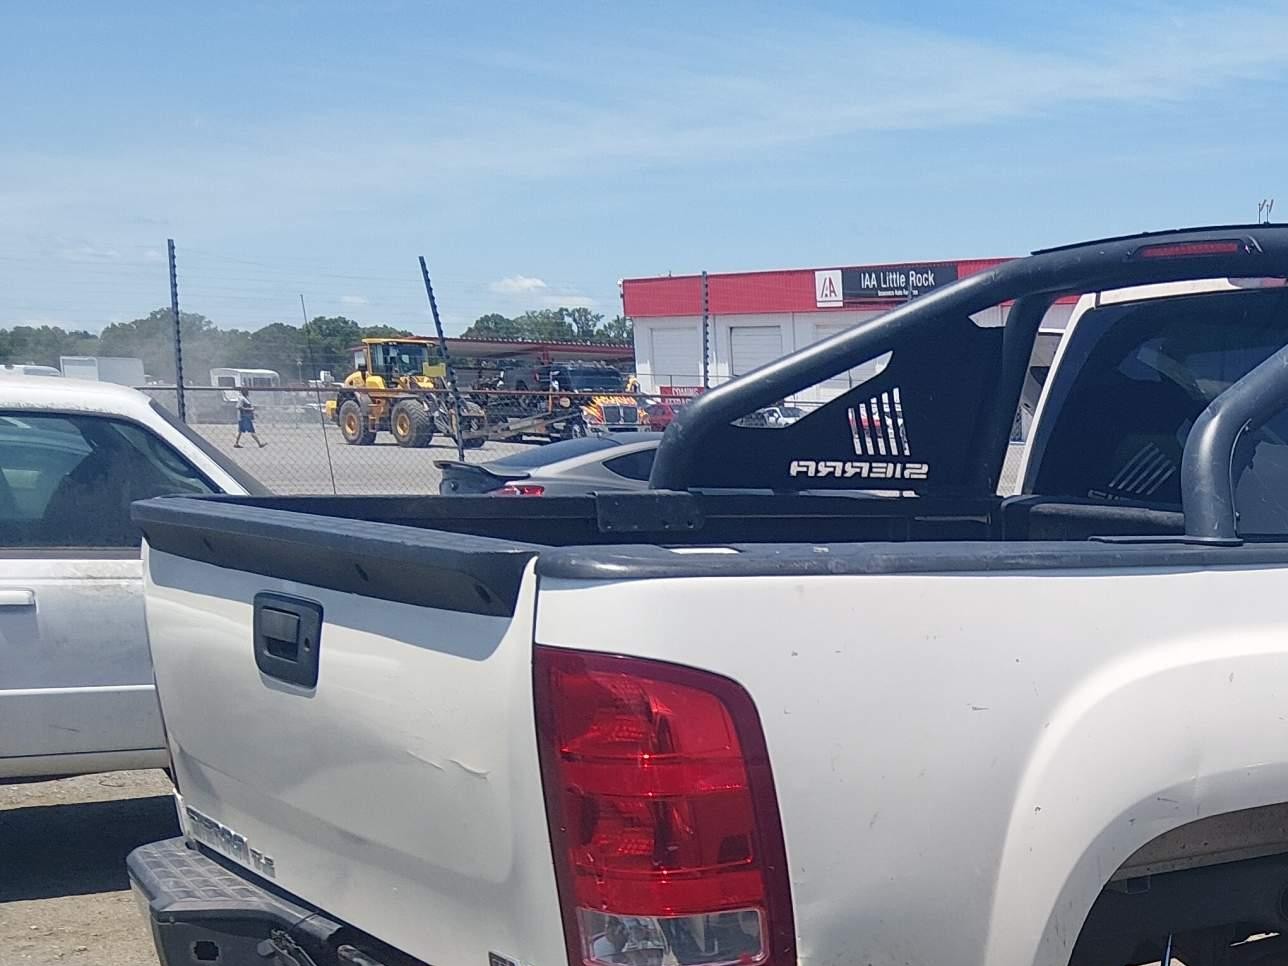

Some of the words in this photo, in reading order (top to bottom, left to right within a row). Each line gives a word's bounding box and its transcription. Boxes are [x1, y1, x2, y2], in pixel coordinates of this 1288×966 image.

[861, 272, 877, 288] IAA
[881, 271, 905, 287] Little
[909, 270, 935, 287] Rock
